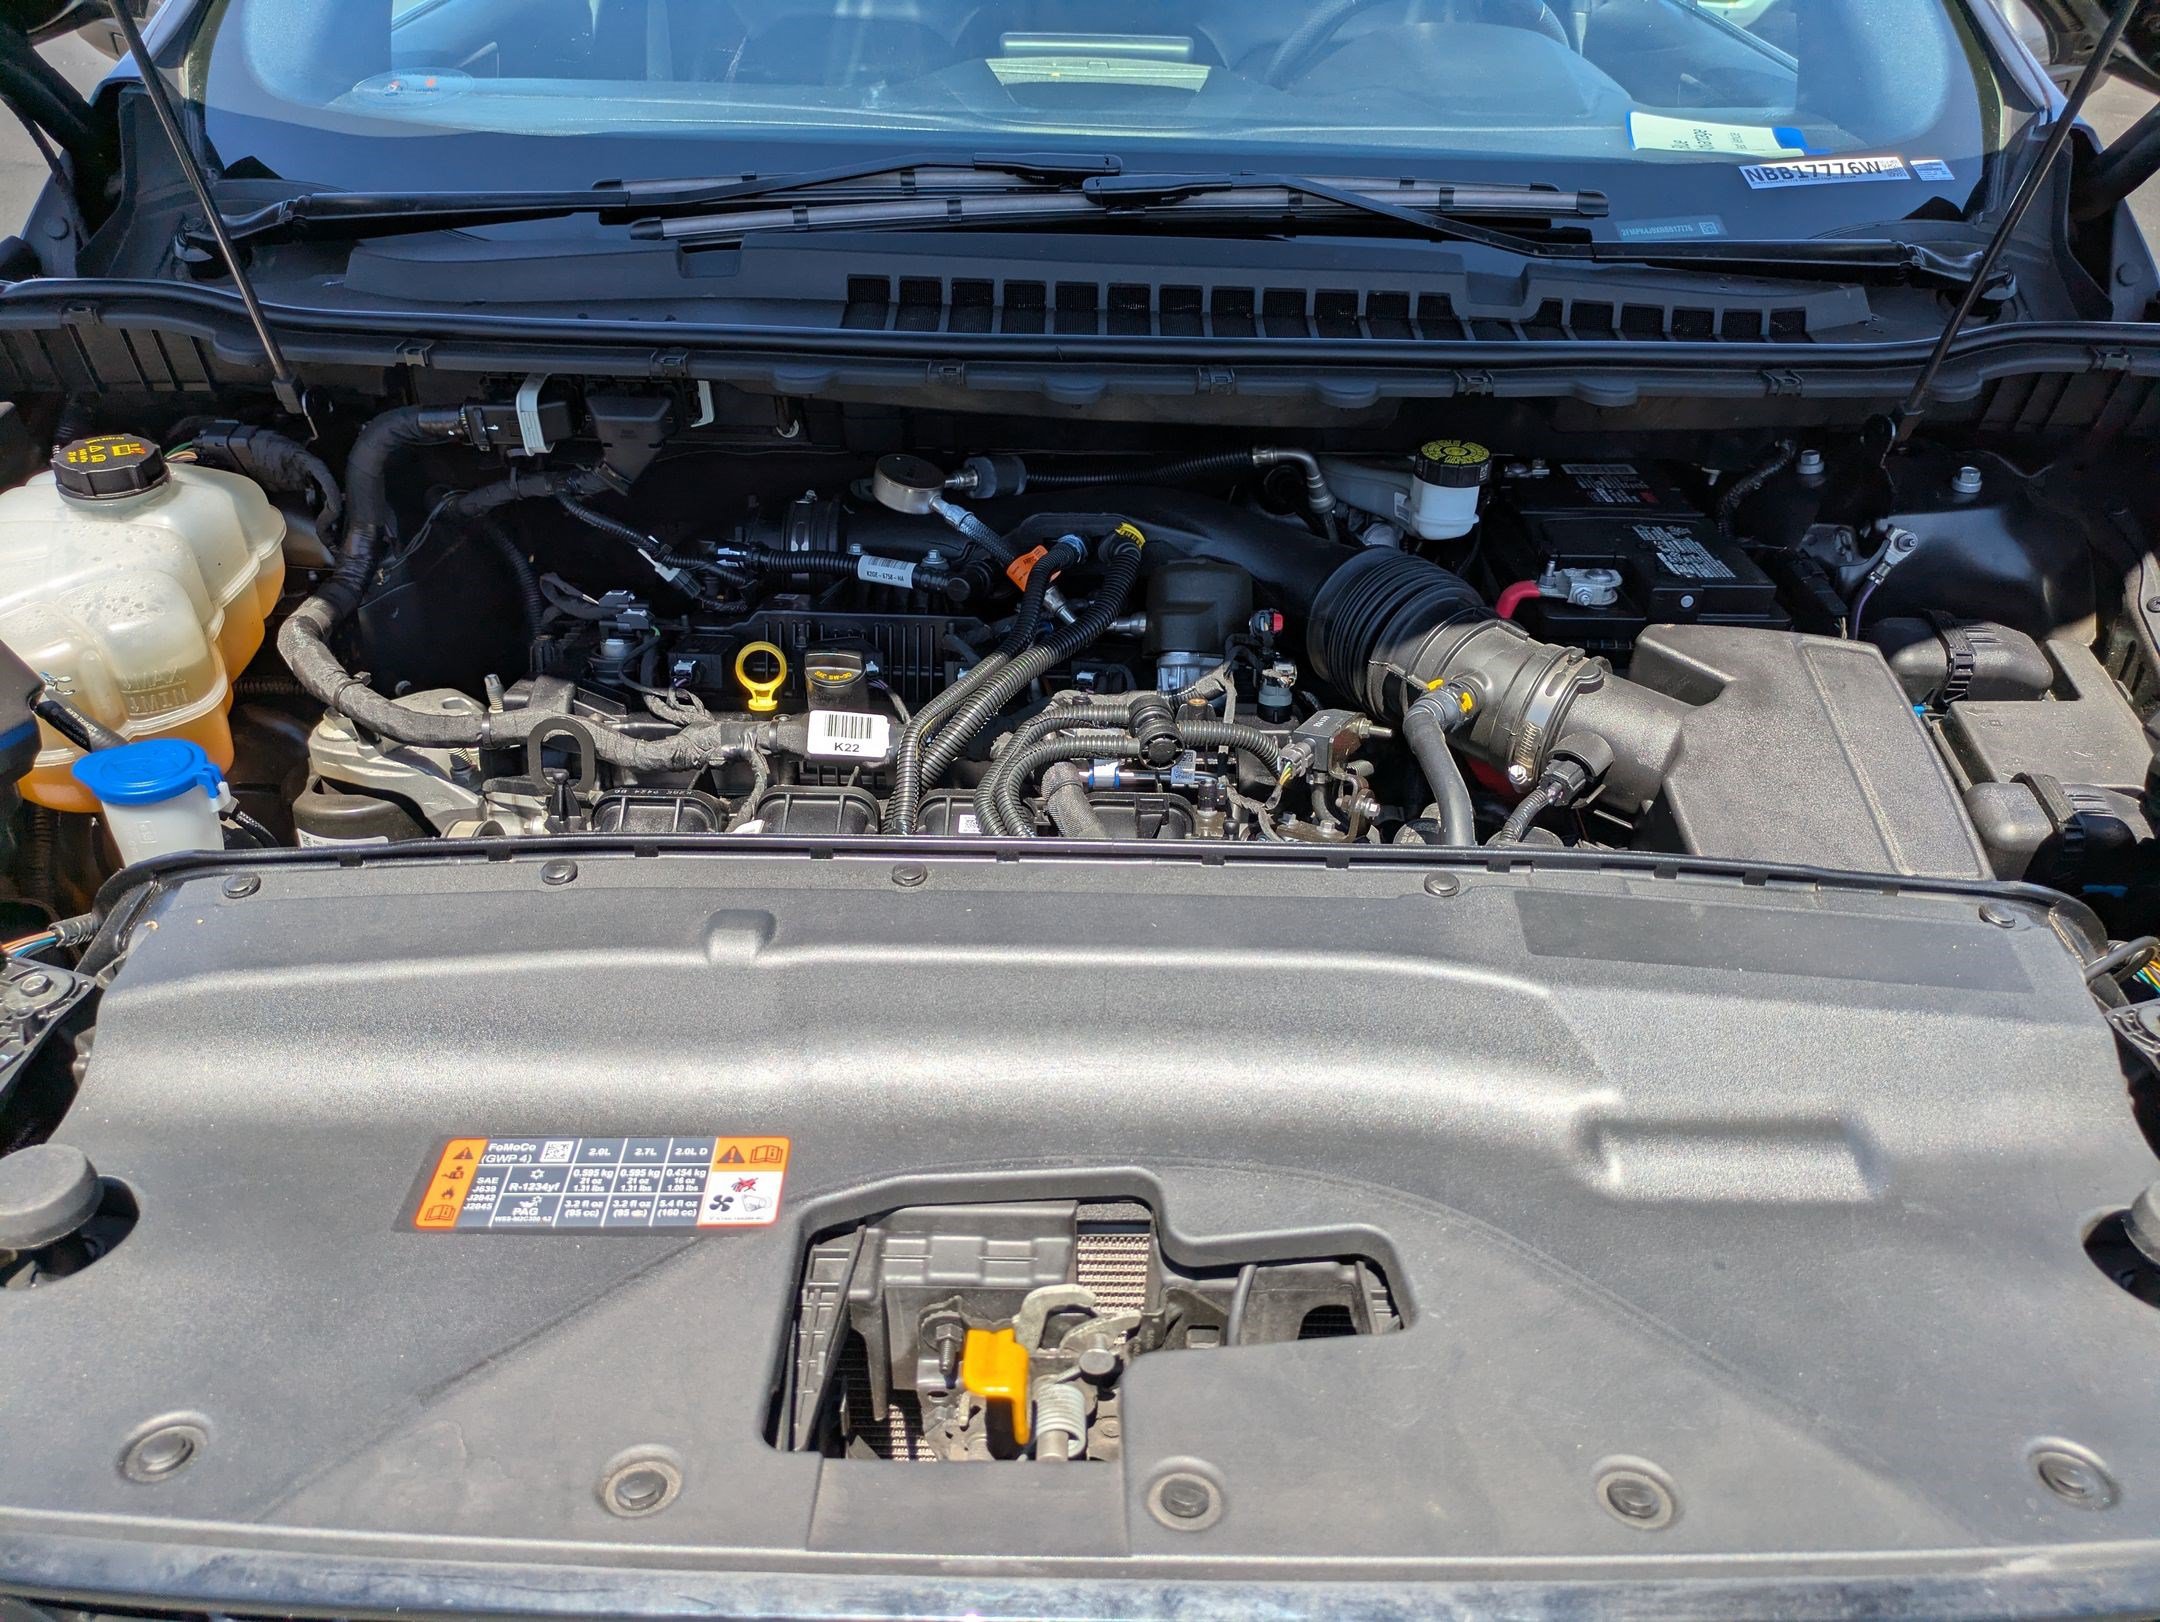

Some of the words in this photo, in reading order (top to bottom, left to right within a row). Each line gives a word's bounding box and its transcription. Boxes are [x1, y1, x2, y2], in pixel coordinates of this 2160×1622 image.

[1744, 161, 1882, 182] NBB17776W
[834, 742, 860, 752] K22
[488, 1143, 537, 1152] FoMoCo
[588, 1147, 611, 1156] 2.0L
[634, 1147, 657, 1156] 2.7L
[675, 1147, 698, 1156] 2.0L
[699, 1147, 708, 1155] D
[481, 1154, 518, 1163] (GWP
[519, 1154, 532, 1163] 4)
[573, 1168, 600, 1177] 0.595
[600, 1168, 614, 1179] kg
[619, 1168, 647, 1177] 0.595
[647, 1168, 661, 1179] kg
[666, 1168, 693, 1177] 0.454
[694, 1168, 707, 1179] kg
[508, 1182, 561, 1192] R-1234yf
[667, 1184, 684, 1192] 1.00
[685, 1184, 698, 1192] lbs
[564, 1200, 580, 1208] 3.2
[581, 1200, 590, 1208] fl
[612, 1200, 628, 1208] 3.2
[630, 1200, 638, 1208] fl
[658, 1200, 674, 1208] 5.4
[676, 1200, 685, 1208] fl
[512, 1207, 539, 1216] PAG
[564, 1208, 581, 1218] (95
[582, 1208, 599, 1218] cc)
[613, 1208, 630, 1218] (95
[657, 1208, 680, 1218] (160
[680, 1208, 697, 1218] cc)
